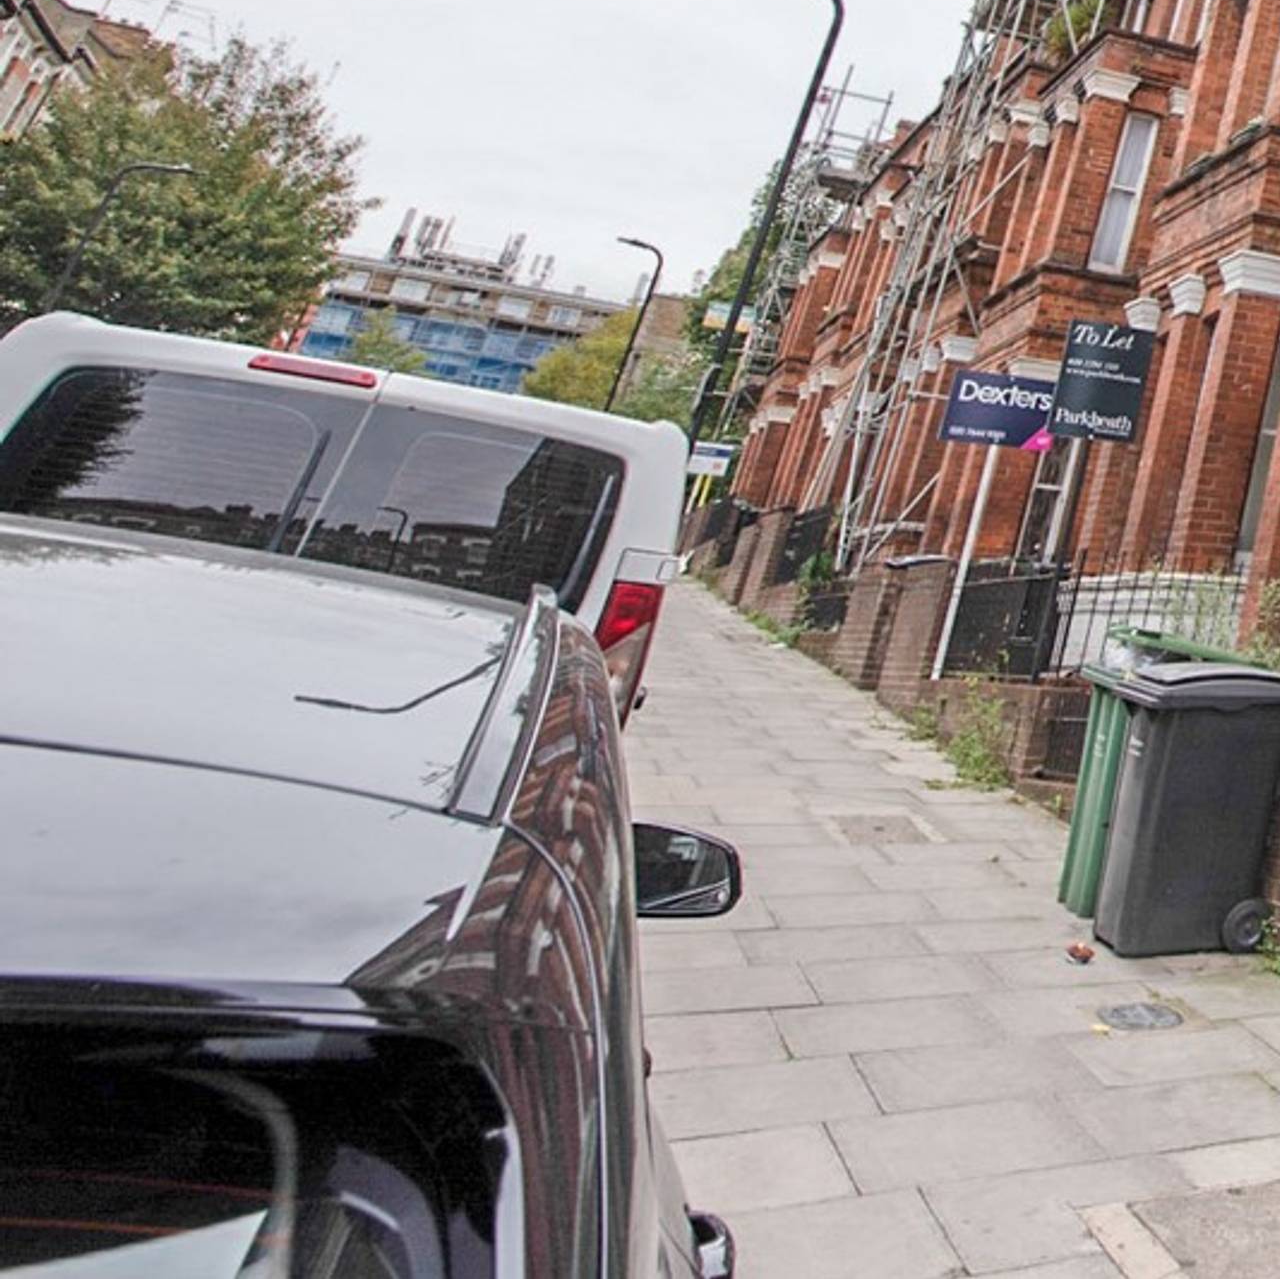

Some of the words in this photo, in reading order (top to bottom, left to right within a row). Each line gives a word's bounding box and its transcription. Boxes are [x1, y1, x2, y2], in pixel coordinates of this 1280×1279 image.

[1073, 323, 1100, 346] To
[1101, 325, 1134, 351] Let
[958, 379, 1053, 411] Dexters
